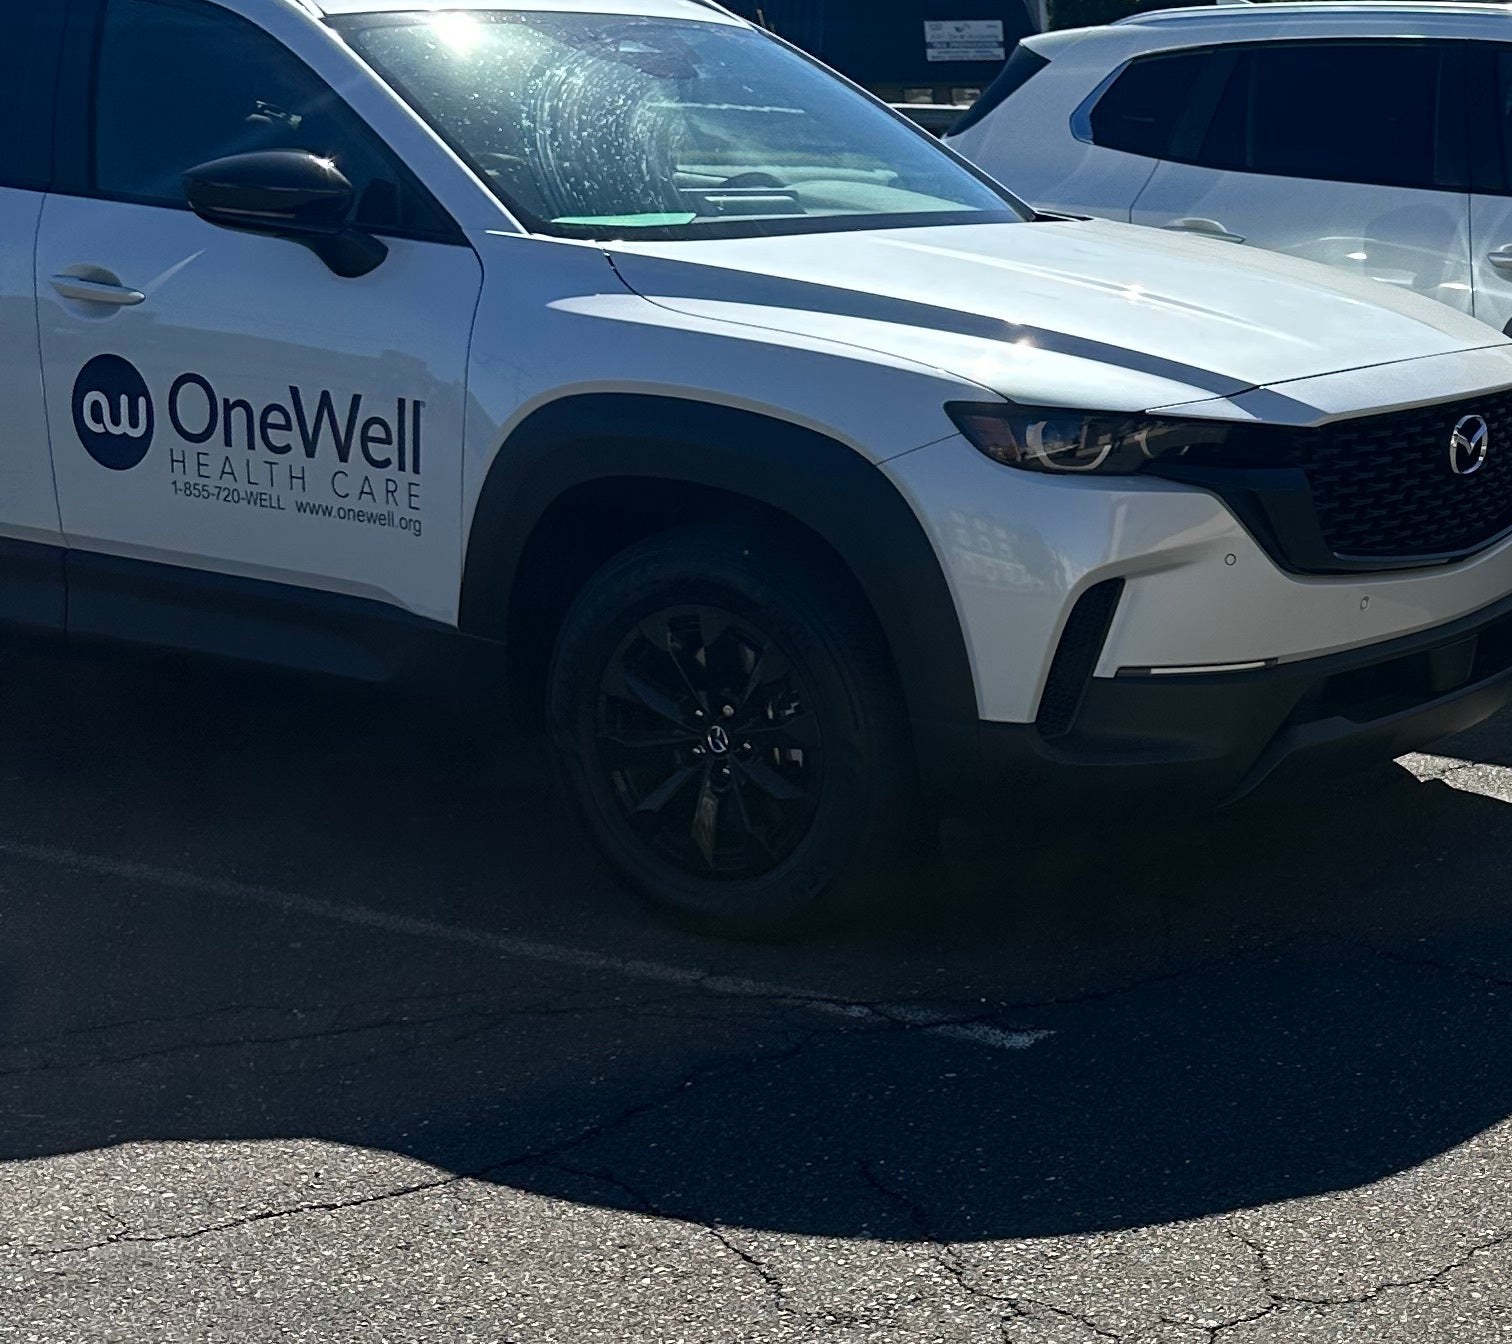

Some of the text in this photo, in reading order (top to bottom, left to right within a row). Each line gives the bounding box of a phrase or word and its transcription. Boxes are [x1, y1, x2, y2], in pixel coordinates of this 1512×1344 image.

[168, 372, 426, 475] OneWell
[169, 447, 421, 511] HEALTH CARE
[170, 479, 422, 537] 1-855-720-WELL www.onewell.org
